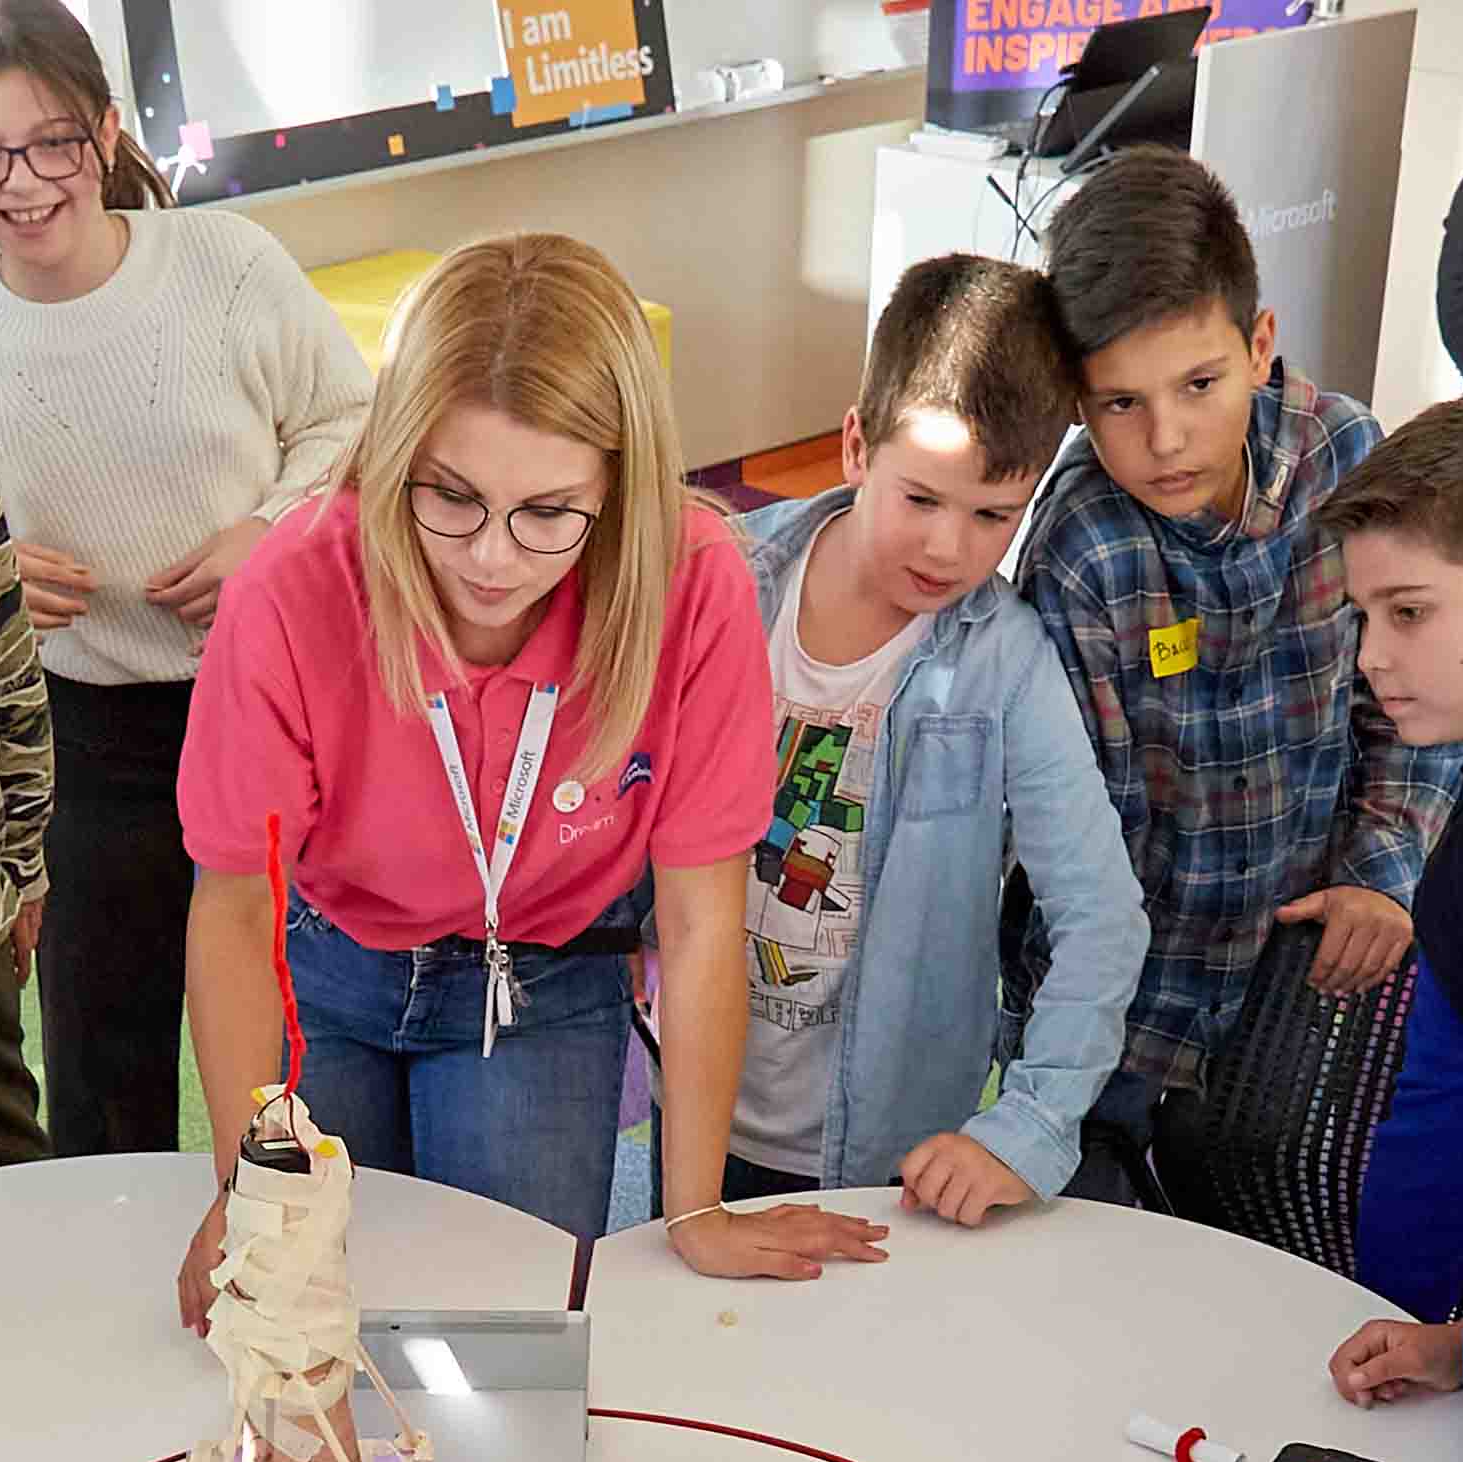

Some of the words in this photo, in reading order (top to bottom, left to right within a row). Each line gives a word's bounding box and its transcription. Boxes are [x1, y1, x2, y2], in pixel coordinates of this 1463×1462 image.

[502, 8, 515, 48] I
[522, 11, 571, 46] am
[965, 0, 1125, 31] ENGAGE
[526, 43, 654, 95] Limitless
[963, 32, 1090, 74] INSPI
[506, 749, 537, 819] Microsoft
